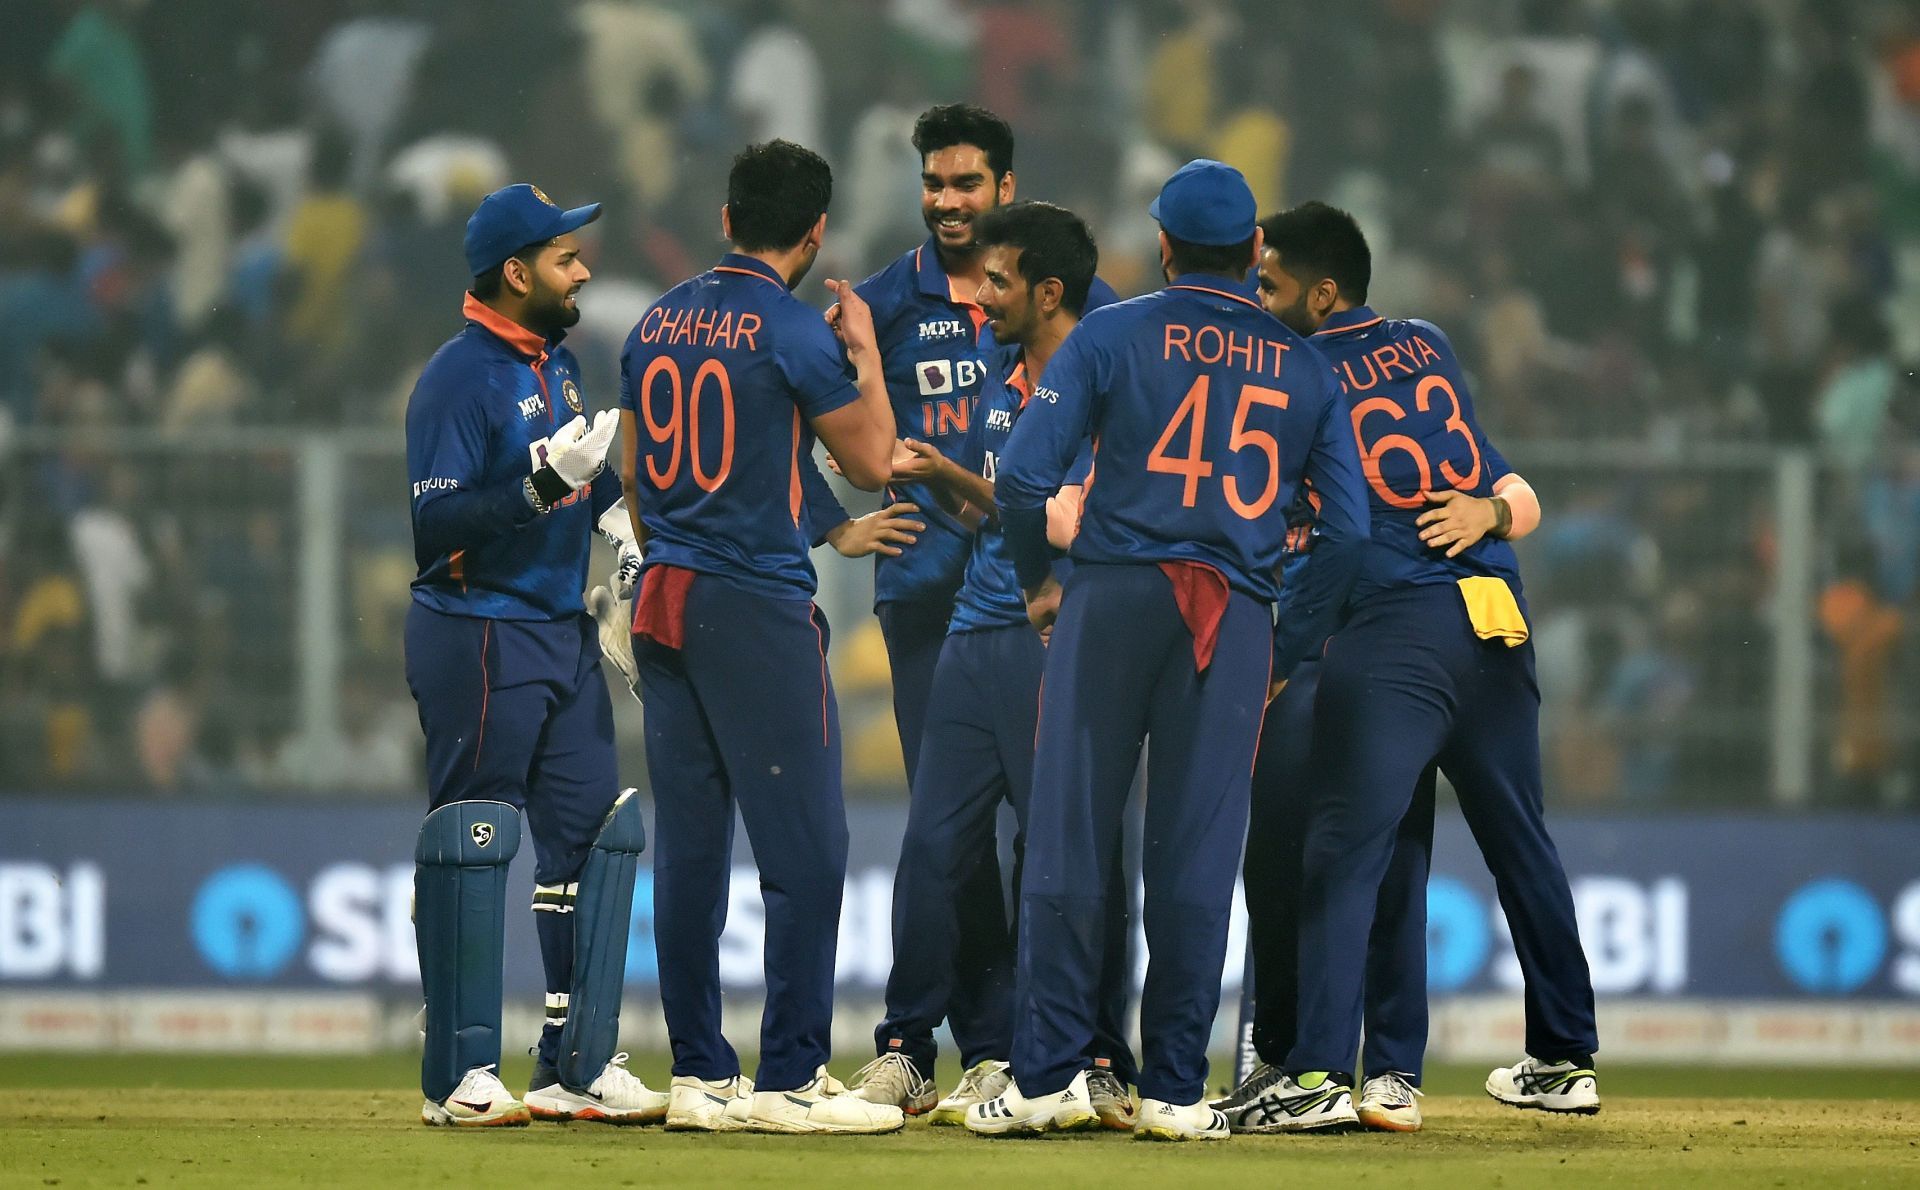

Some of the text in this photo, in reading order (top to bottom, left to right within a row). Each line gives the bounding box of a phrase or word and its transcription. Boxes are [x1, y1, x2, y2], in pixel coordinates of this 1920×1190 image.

[640, 306, 762, 351] CHAHAR
[919, 320, 965, 336] MPL
[1164, 324, 1290, 378] ROHIT
[517, 393, 545, 416] MPL
[1034, 385, 1060, 404] JU'S
[641, 355, 736, 493] 90
[922, 396, 980, 437] IN
[987, 408, 1012, 427] MPL
[1146, 374, 1290, 520] 45
[1351, 374, 1481, 509] 63
